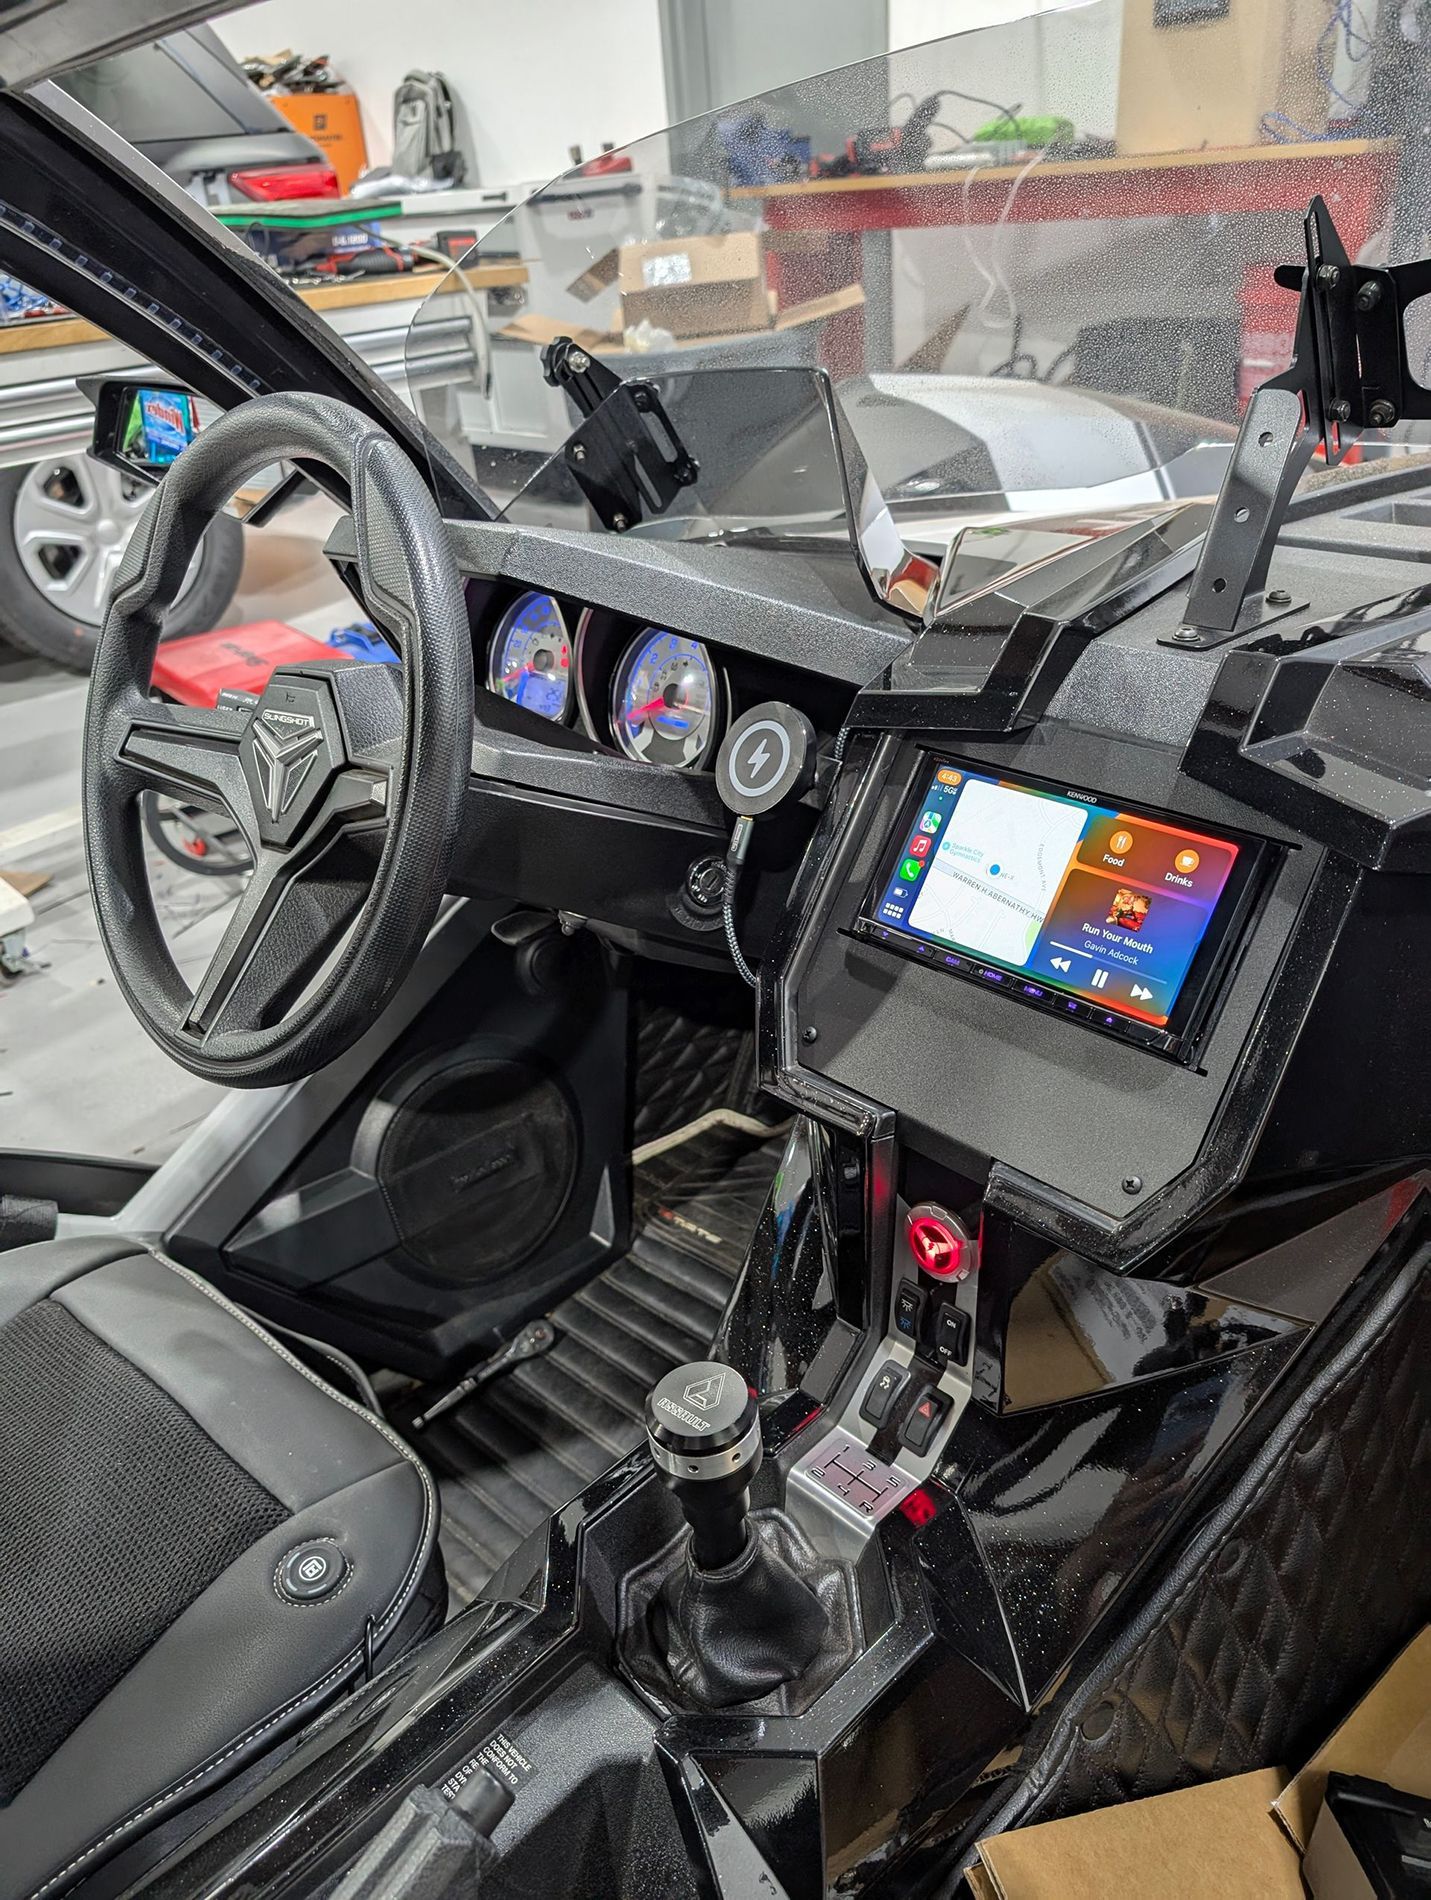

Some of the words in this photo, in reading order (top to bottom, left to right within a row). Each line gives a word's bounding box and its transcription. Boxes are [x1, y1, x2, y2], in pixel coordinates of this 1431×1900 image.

[264, 712, 309, 727] SLINGSHOT
[1067, 790, 1098, 804] KENWOOD
[1103, 854, 1125, 867] Food
[1165, 872, 1194, 888] Drinks
[952, 871, 981, 891] WARREN
[987, 890, 1031, 918] ABERNATHY
[1081, 923, 1100, 936] Run
[1102, 929, 1123, 943] Your
[1123, 937, 1154, 954] Mouth
[1084, 941, 1107, 955] Gavin
[1107, 948, 1139, 965] Adcock
[983, 970, 1003, 982] HOME
[946, 1319, 957, 1329] ON
[939, 1346, 953, 1356] OFF
[656, 1397, 711, 1432] ASSAULT
[863, 1459, 877, 1471] 3
[886, 1475, 900, 1488] 5
[811, 1466, 826, 1478] 2
[859, 1500, 874, 1513] R
[476, 1751, 490, 1766] THE
[489, 1740, 507, 1759] DOES
[503, 1755, 518, 1770] NOT
[496, 1733, 510, 1749] THIS
[508, 1745, 532, 1772] VEHICLE
[462, 1765, 473, 1775] OF
[483, 1746, 511, 1777] CONFORM
[508, 1772, 519, 1785] TO
